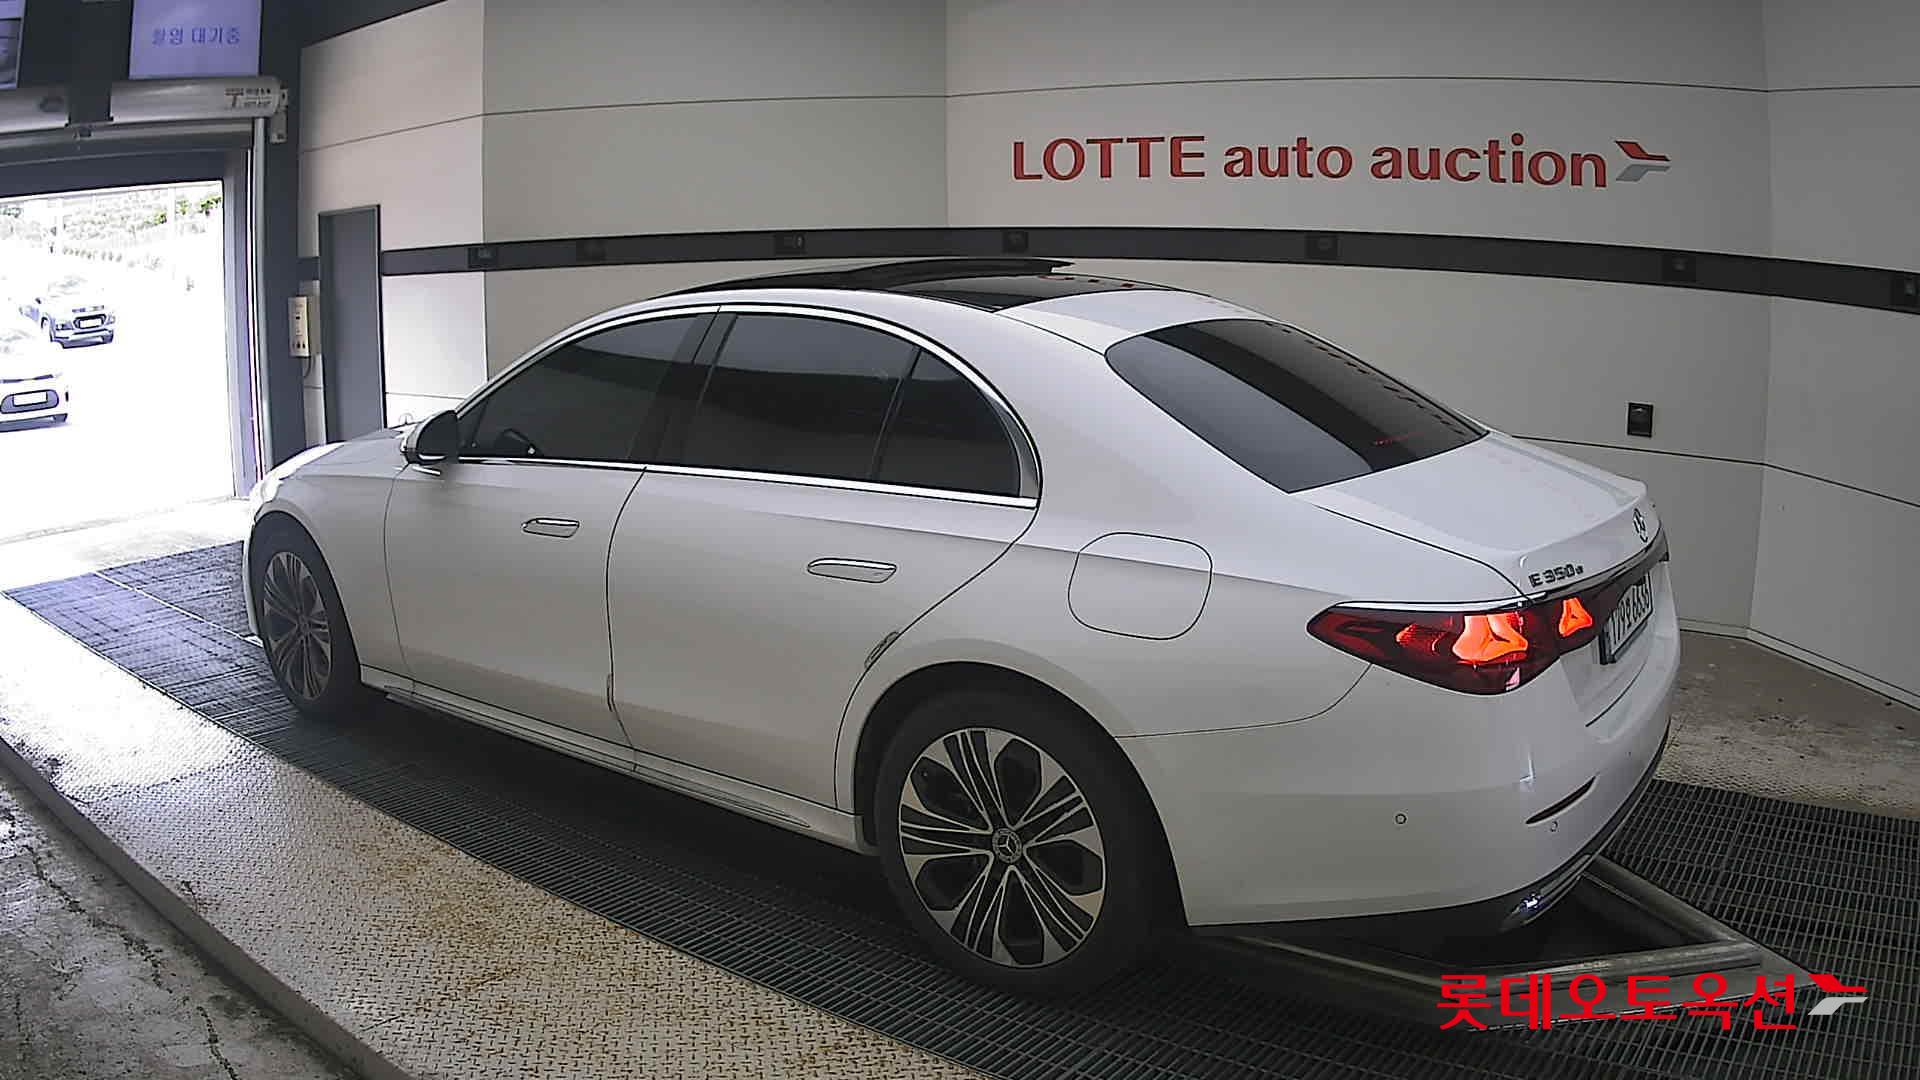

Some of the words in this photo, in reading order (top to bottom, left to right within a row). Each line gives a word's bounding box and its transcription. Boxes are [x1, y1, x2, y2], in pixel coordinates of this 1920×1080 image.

[1013, 136, 1206, 181] LOTTE
[1223, 137, 1353, 179] auto
[1370, 133, 1607, 188] auction
[1528, 573, 1541, 588] E
